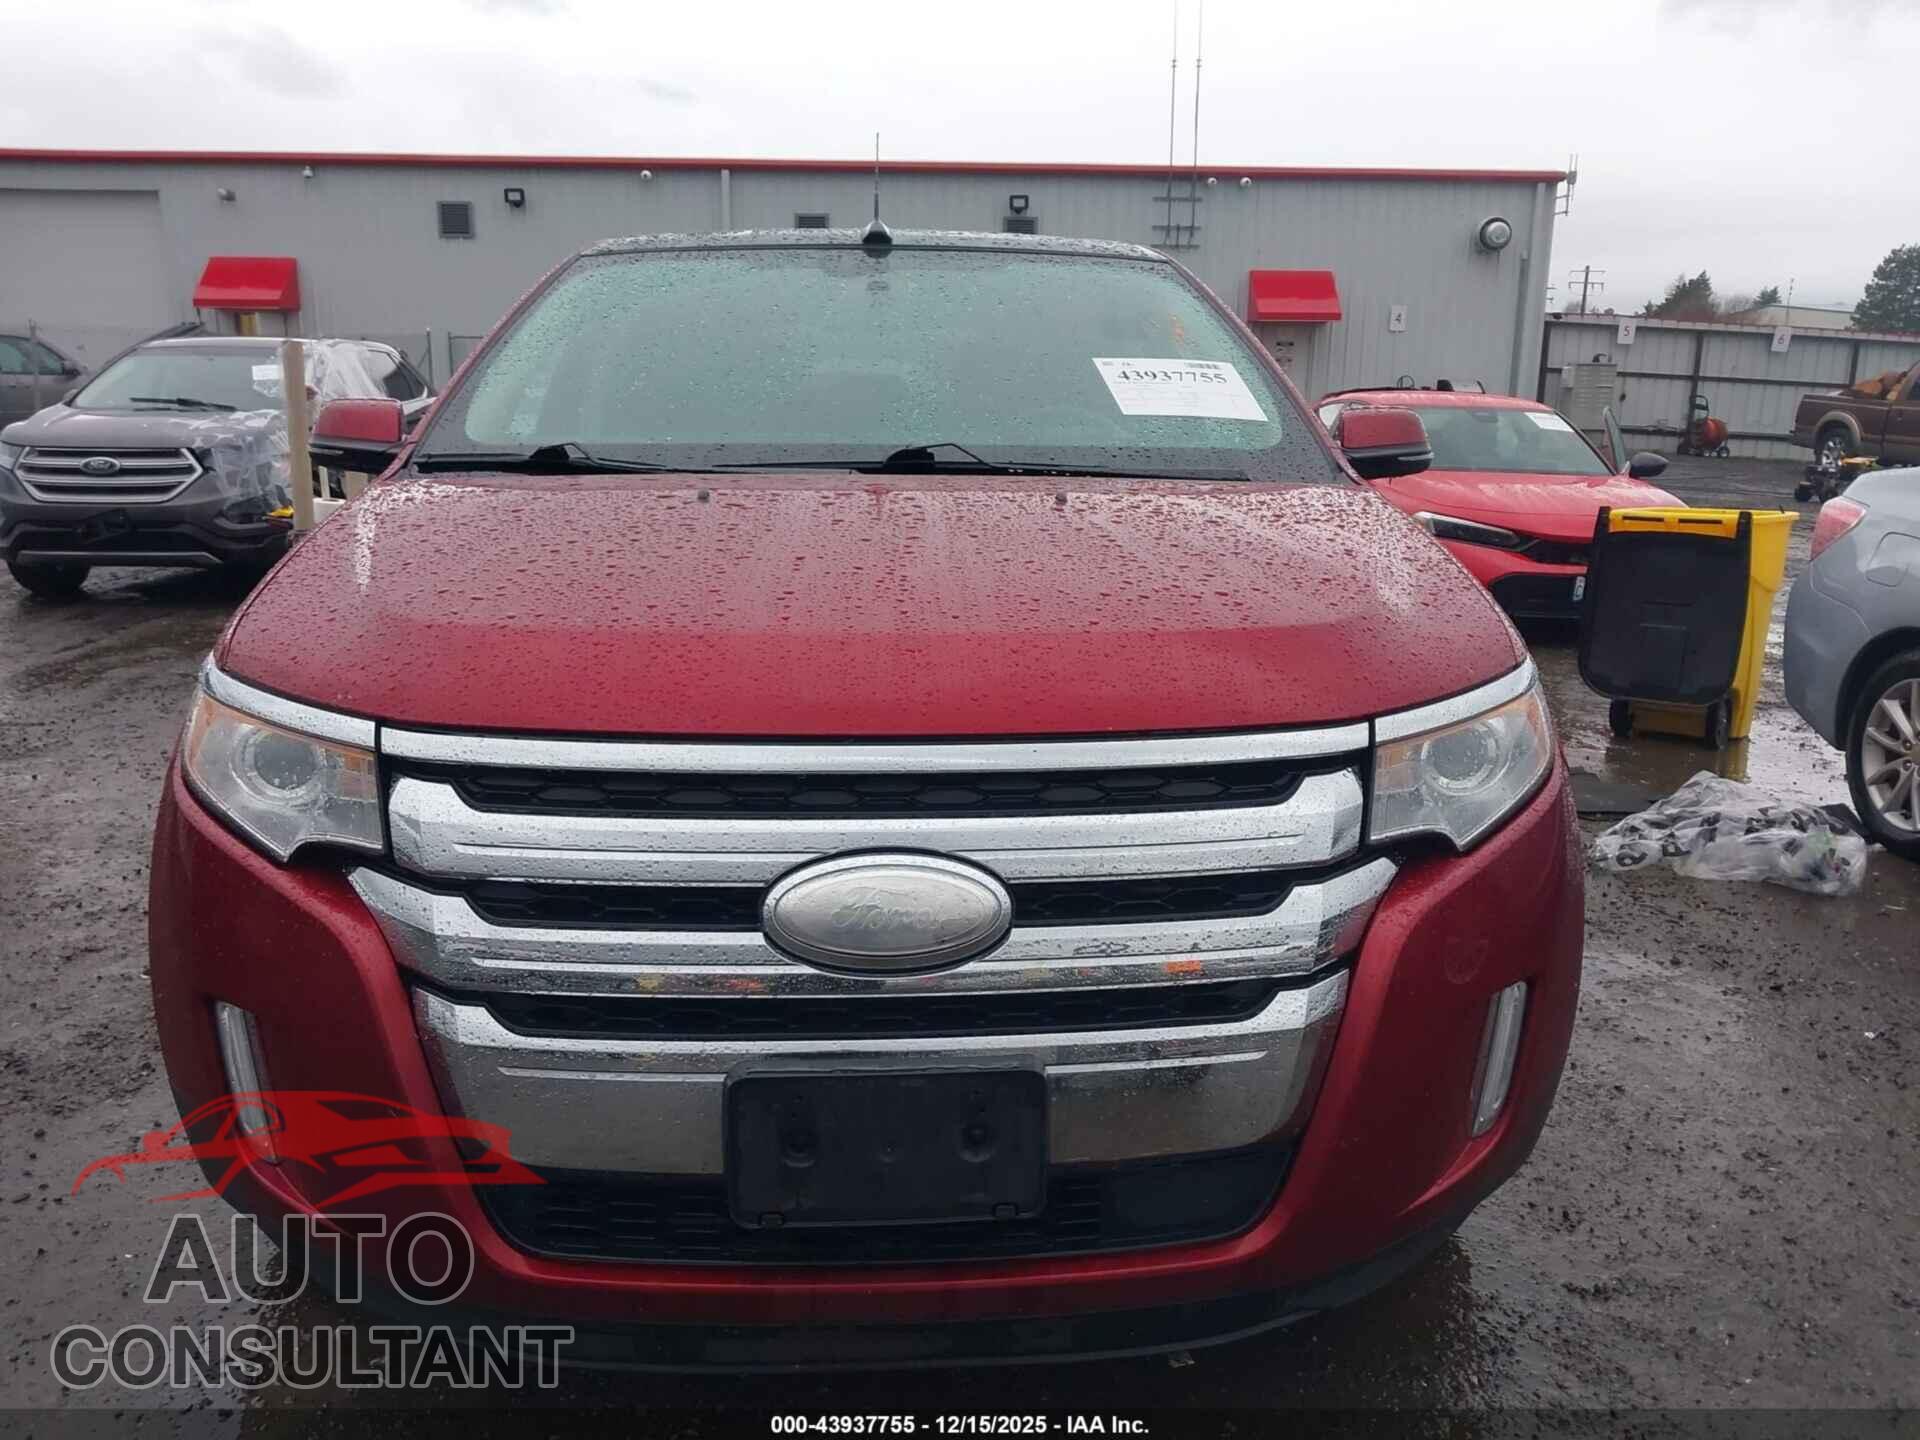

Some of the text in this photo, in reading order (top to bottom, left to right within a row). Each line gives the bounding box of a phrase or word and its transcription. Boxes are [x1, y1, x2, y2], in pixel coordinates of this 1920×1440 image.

[1394, 312, 1402, 325] 4
[1623, 327, 1631, 337] 5
[1777, 334, 1786, 345] 6
[1117, 369, 1228, 384] 43937755
